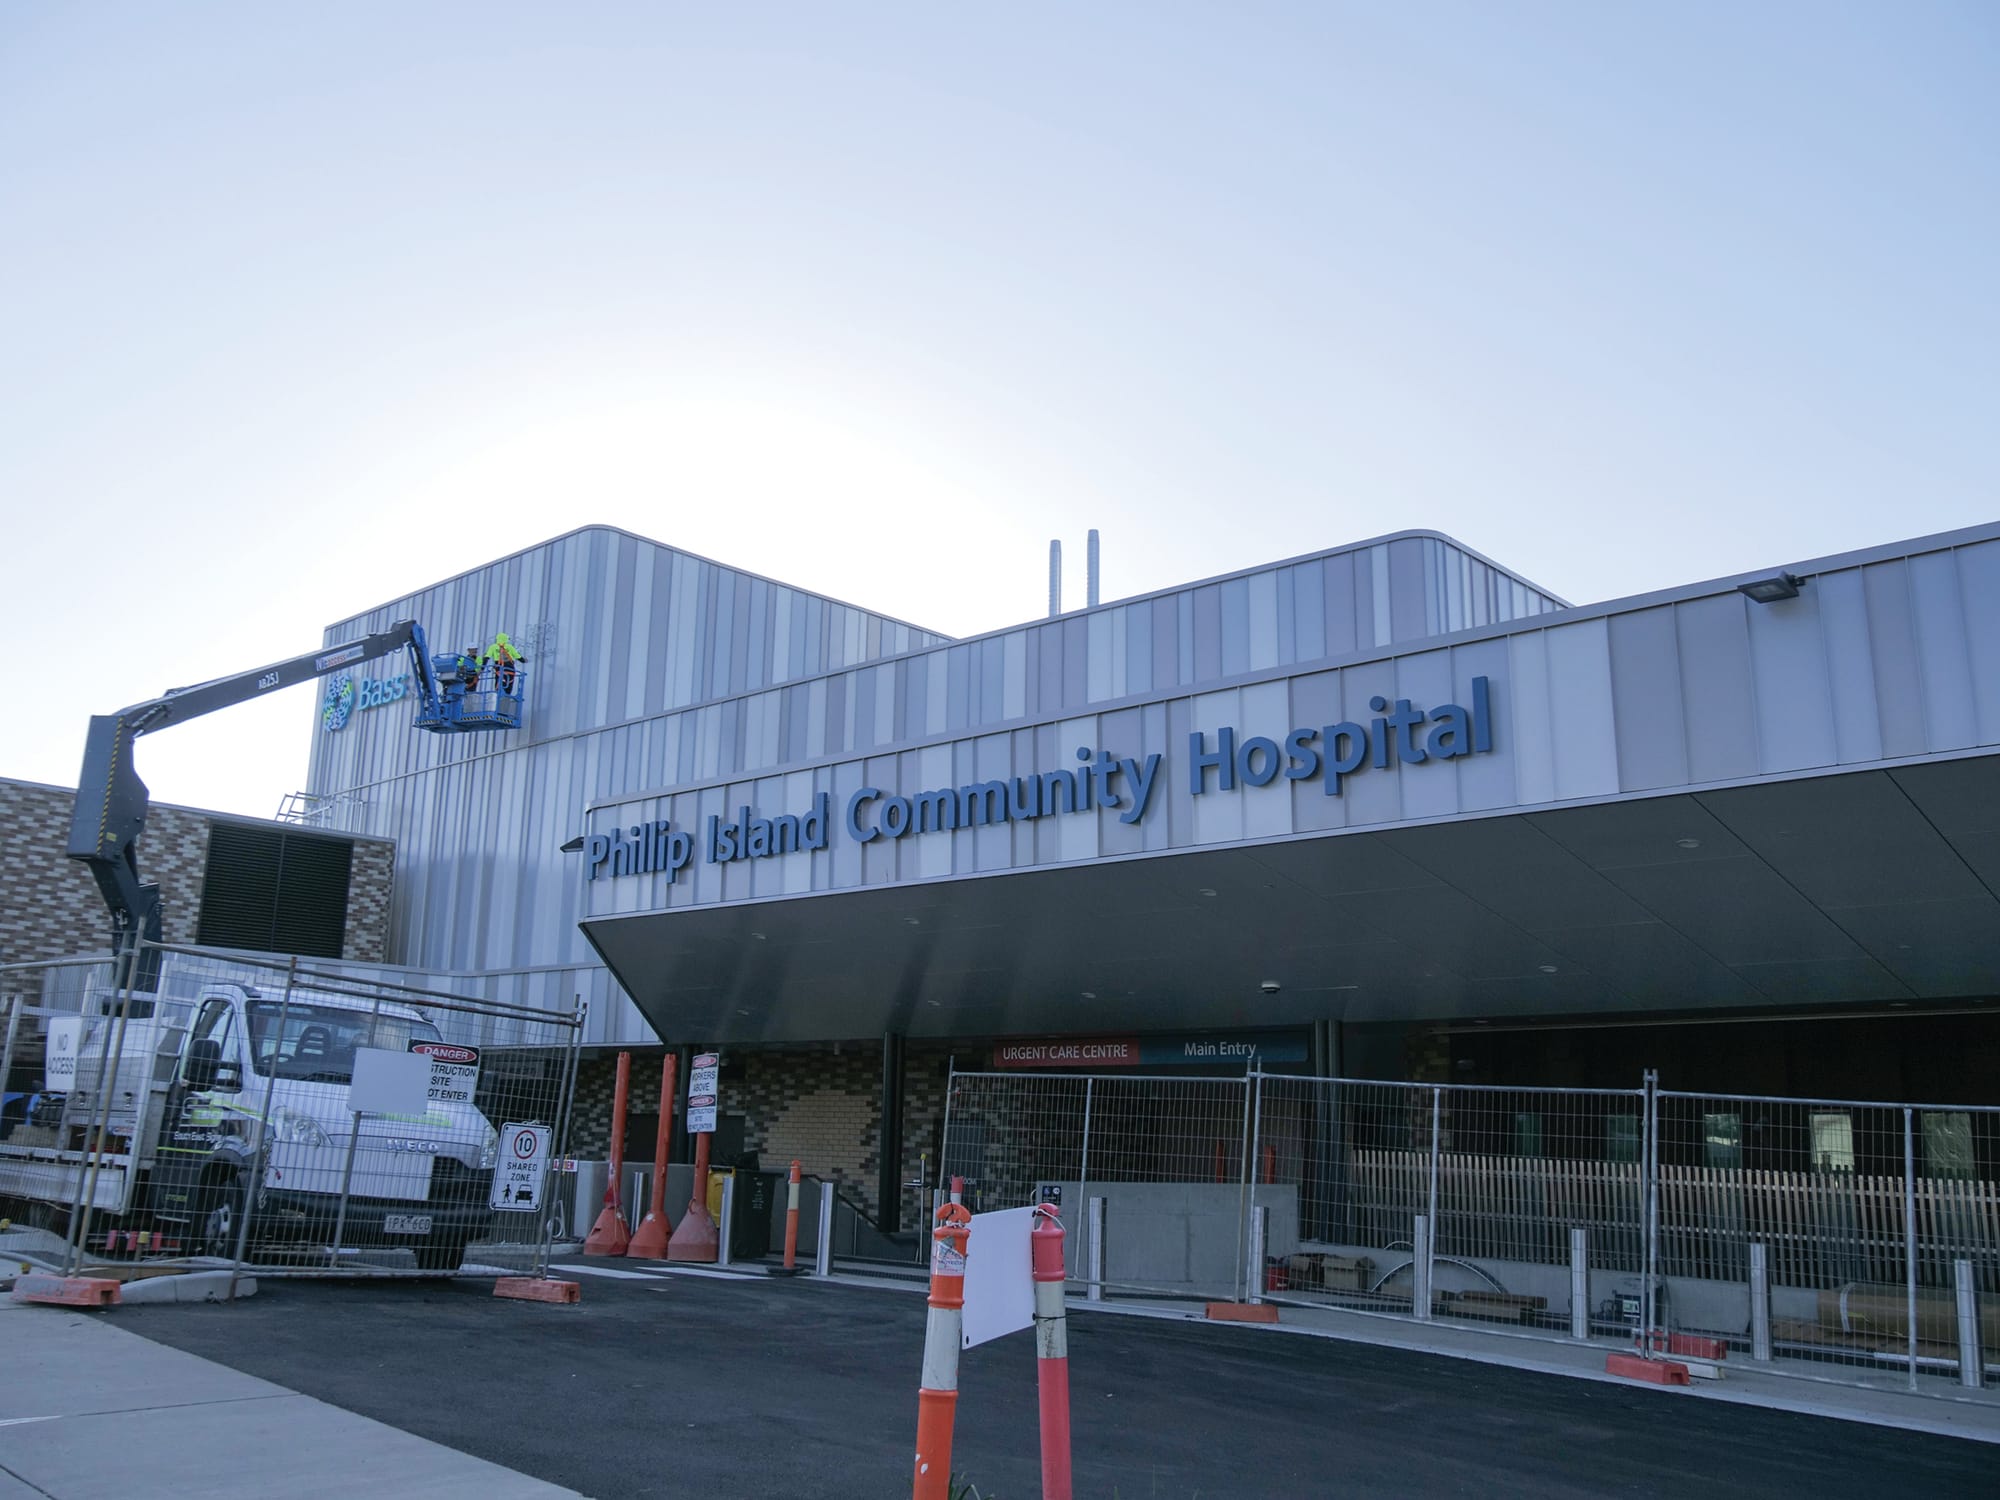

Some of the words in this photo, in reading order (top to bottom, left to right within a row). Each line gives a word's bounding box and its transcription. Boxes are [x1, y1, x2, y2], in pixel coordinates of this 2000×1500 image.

[356, 674, 409, 712] Bass
[586, 820, 692, 883] Phillip
[706, 792, 829, 863] Island
[846, 746, 1161, 843] Community
[1189, 676, 1492, 796] Hospital
[424, 1046, 469, 1060] DANGER
[1003, 1046, 1047, 1060] URGENT
[1050, 1045, 1079, 1060] CARE
[1082, 1044, 1128, 1059] CENTRE
[1184, 1042, 1216, 1056] Main
[1219, 1041, 1256, 1059] Entry
[431, 1064, 476, 1077] TRUCTION
[431, 1076, 452, 1086] SITE
[441, 1089, 468, 1101] ENTER
[518, 1137, 532, 1152] 10
[507, 1161, 537, 1172] SHARED
[511, 1173, 530, 1182] ZONE
